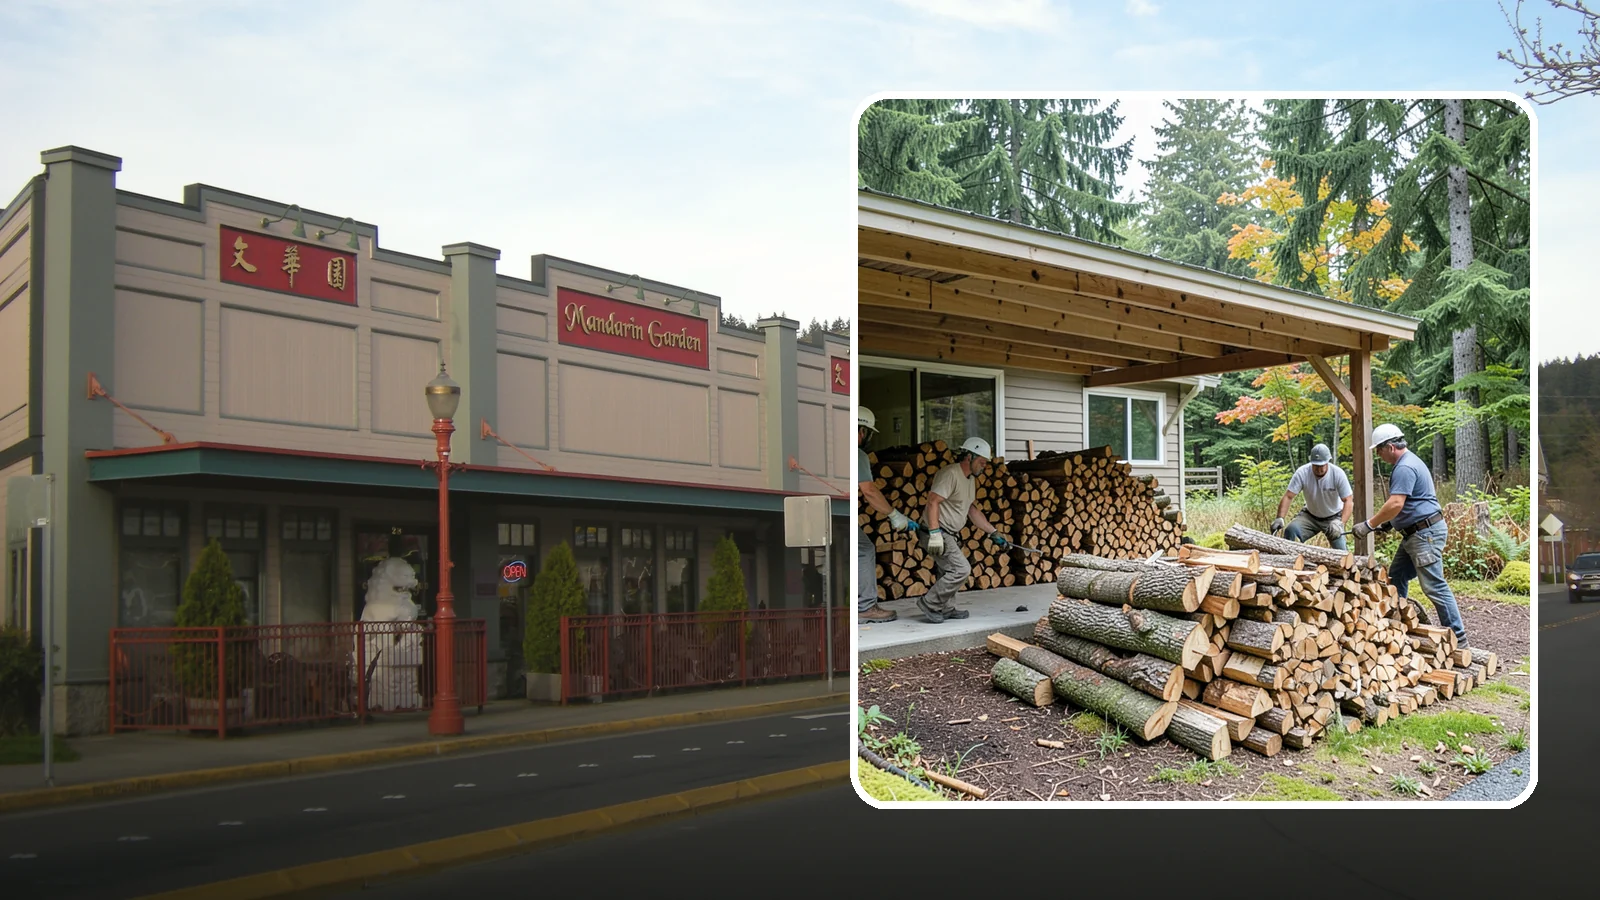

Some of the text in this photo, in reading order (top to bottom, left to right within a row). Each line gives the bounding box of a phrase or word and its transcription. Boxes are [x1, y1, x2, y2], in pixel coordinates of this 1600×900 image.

[231, 235, 347, 291] 文華園
[564, 302, 702, 353] Mandarin Garden
[503, 565, 527, 578] OPEN
